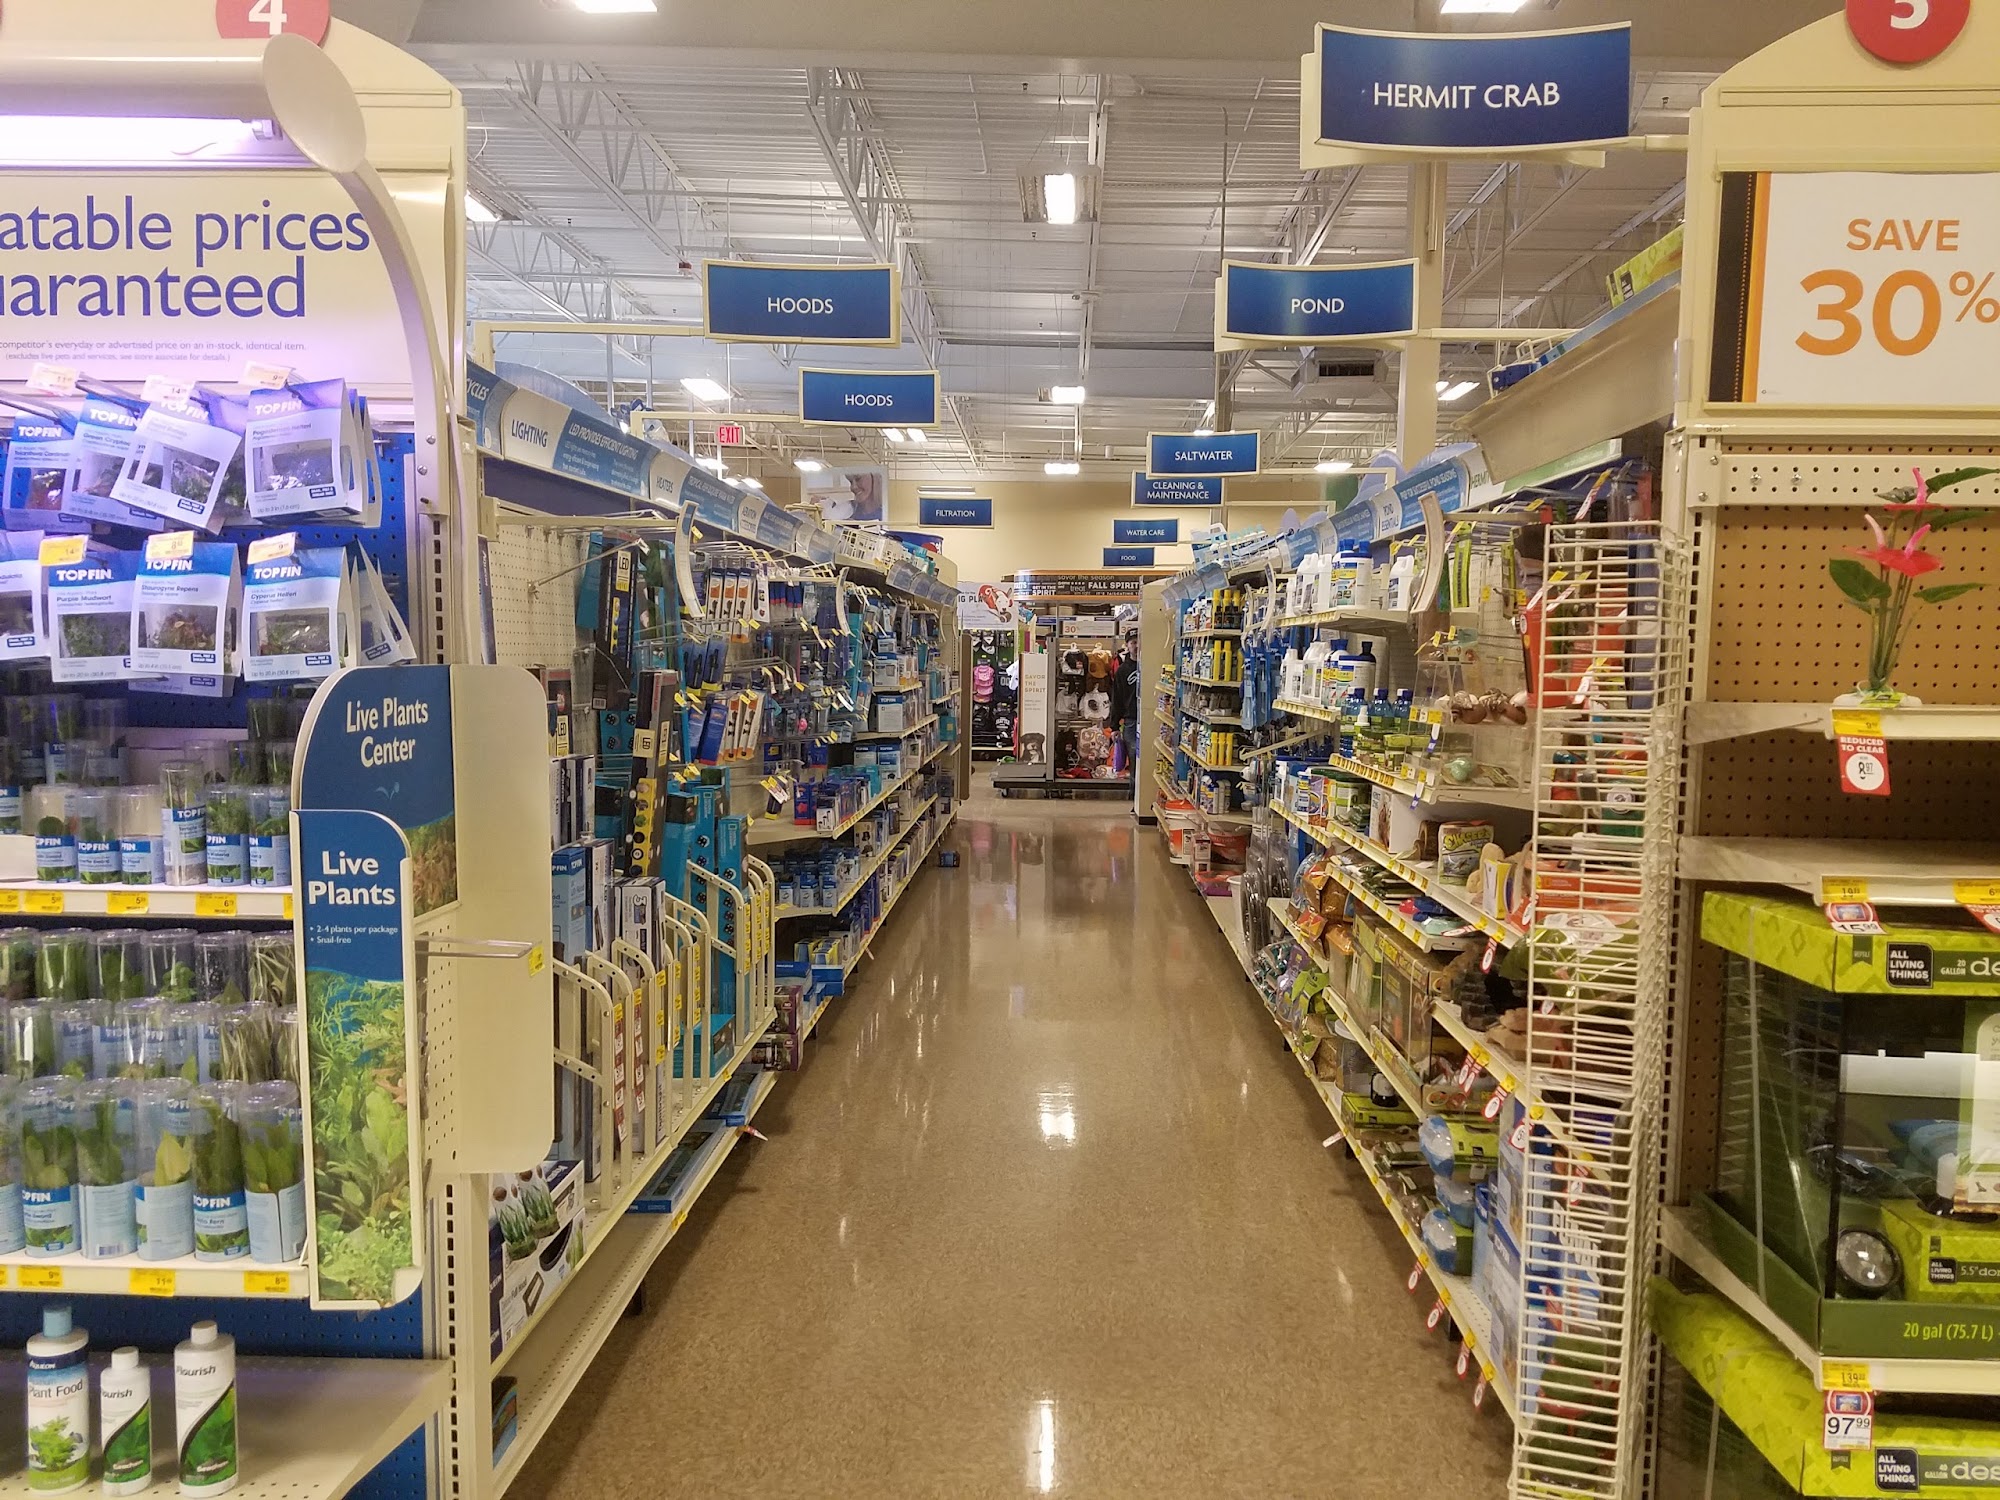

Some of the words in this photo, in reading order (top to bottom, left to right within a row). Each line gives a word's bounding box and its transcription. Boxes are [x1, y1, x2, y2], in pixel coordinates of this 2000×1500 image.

[248, 0, 287, 35] 4
[1374, 82, 1476, 109] HERMIT
[1484, 82, 1560, 108] CRAB
[196, 199, 370, 267] prices
[1846, 218, 1960, 252] SAVE
[0, 255, 306, 318] aranteed
[767, 297, 834, 315] HOODS
[1291, 298, 1345, 315] POND
[1795, 268, 2000, 356] 30%
[55, 341, 94, 351] everyday
[108, 341, 153, 350] advertised
[155, 341, 178, 351] price
[246, 341, 282, 350] identical
[844, 394, 893, 407] HOODS
[511, 418, 549, 448] LIGHTING
[719, 426, 740, 444] EXIT
[568, 423, 578, 436] LED
[577, 426, 601, 446] PROVIDES
[618, 444, 639, 460] LIGHTING
[1174, 451, 1233, 461] SALTWATER
[656, 475, 674, 494] HEATERS
[1152, 481, 1196, 490] CLEANING
[1197, 481, 1204, 490] &
[1146, 491, 1210, 500] MAINTENANCE
[935, 509, 975, 518] FILTRATION
[618, 555, 629, 571] LED
[1088, 581, 1107, 589] FALL
[1110, 581, 1139, 589] SPIRIT
[346, 701, 379, 733] Live
[383, 697, 429, 729] Plants
[557, 722, 567, 737] LED
[642, 737, 651, 750] LED
[1840, 736, 1884, 747] REDUCED
[360, 736, 416, 768] Center
[1856, 744, 1885, 754] CLEAR
[322, 850, 379, 875] Live
[308, 880, 396, 905] Plants
[316, 925, 329, 933] 2-4
[330, 925, 352, 935] plants
[353, 926, 366, 935] per
[368, 925, 398, 936] package
[316, 935, 352, 944] Snail-free
[1890, 950, 1909, 959] ALL
[1890, 960, 1925, 969] LIVING
[1957, 959, 1966, 967] 20
[1890, 970, 1929, 979] THINGS
[1940, 967, 1966, 976] GALLON
[1903, 1322, 1919, 1338] 20
[1922, 1323, 1943, 1340] gal
[1946, 1324, 1979, 1341] (75.7
[1981, 1324, 1994, 1342] L)
[29, 1384, 52, 1399] Plant
[56, 1379, 84, 1398] Food
[1878, 1454, 1896, 1464] ALL
[1878, 1464, 1911, 1473] LIVING
[1878, 1474, 1915, 1484] THINGS
